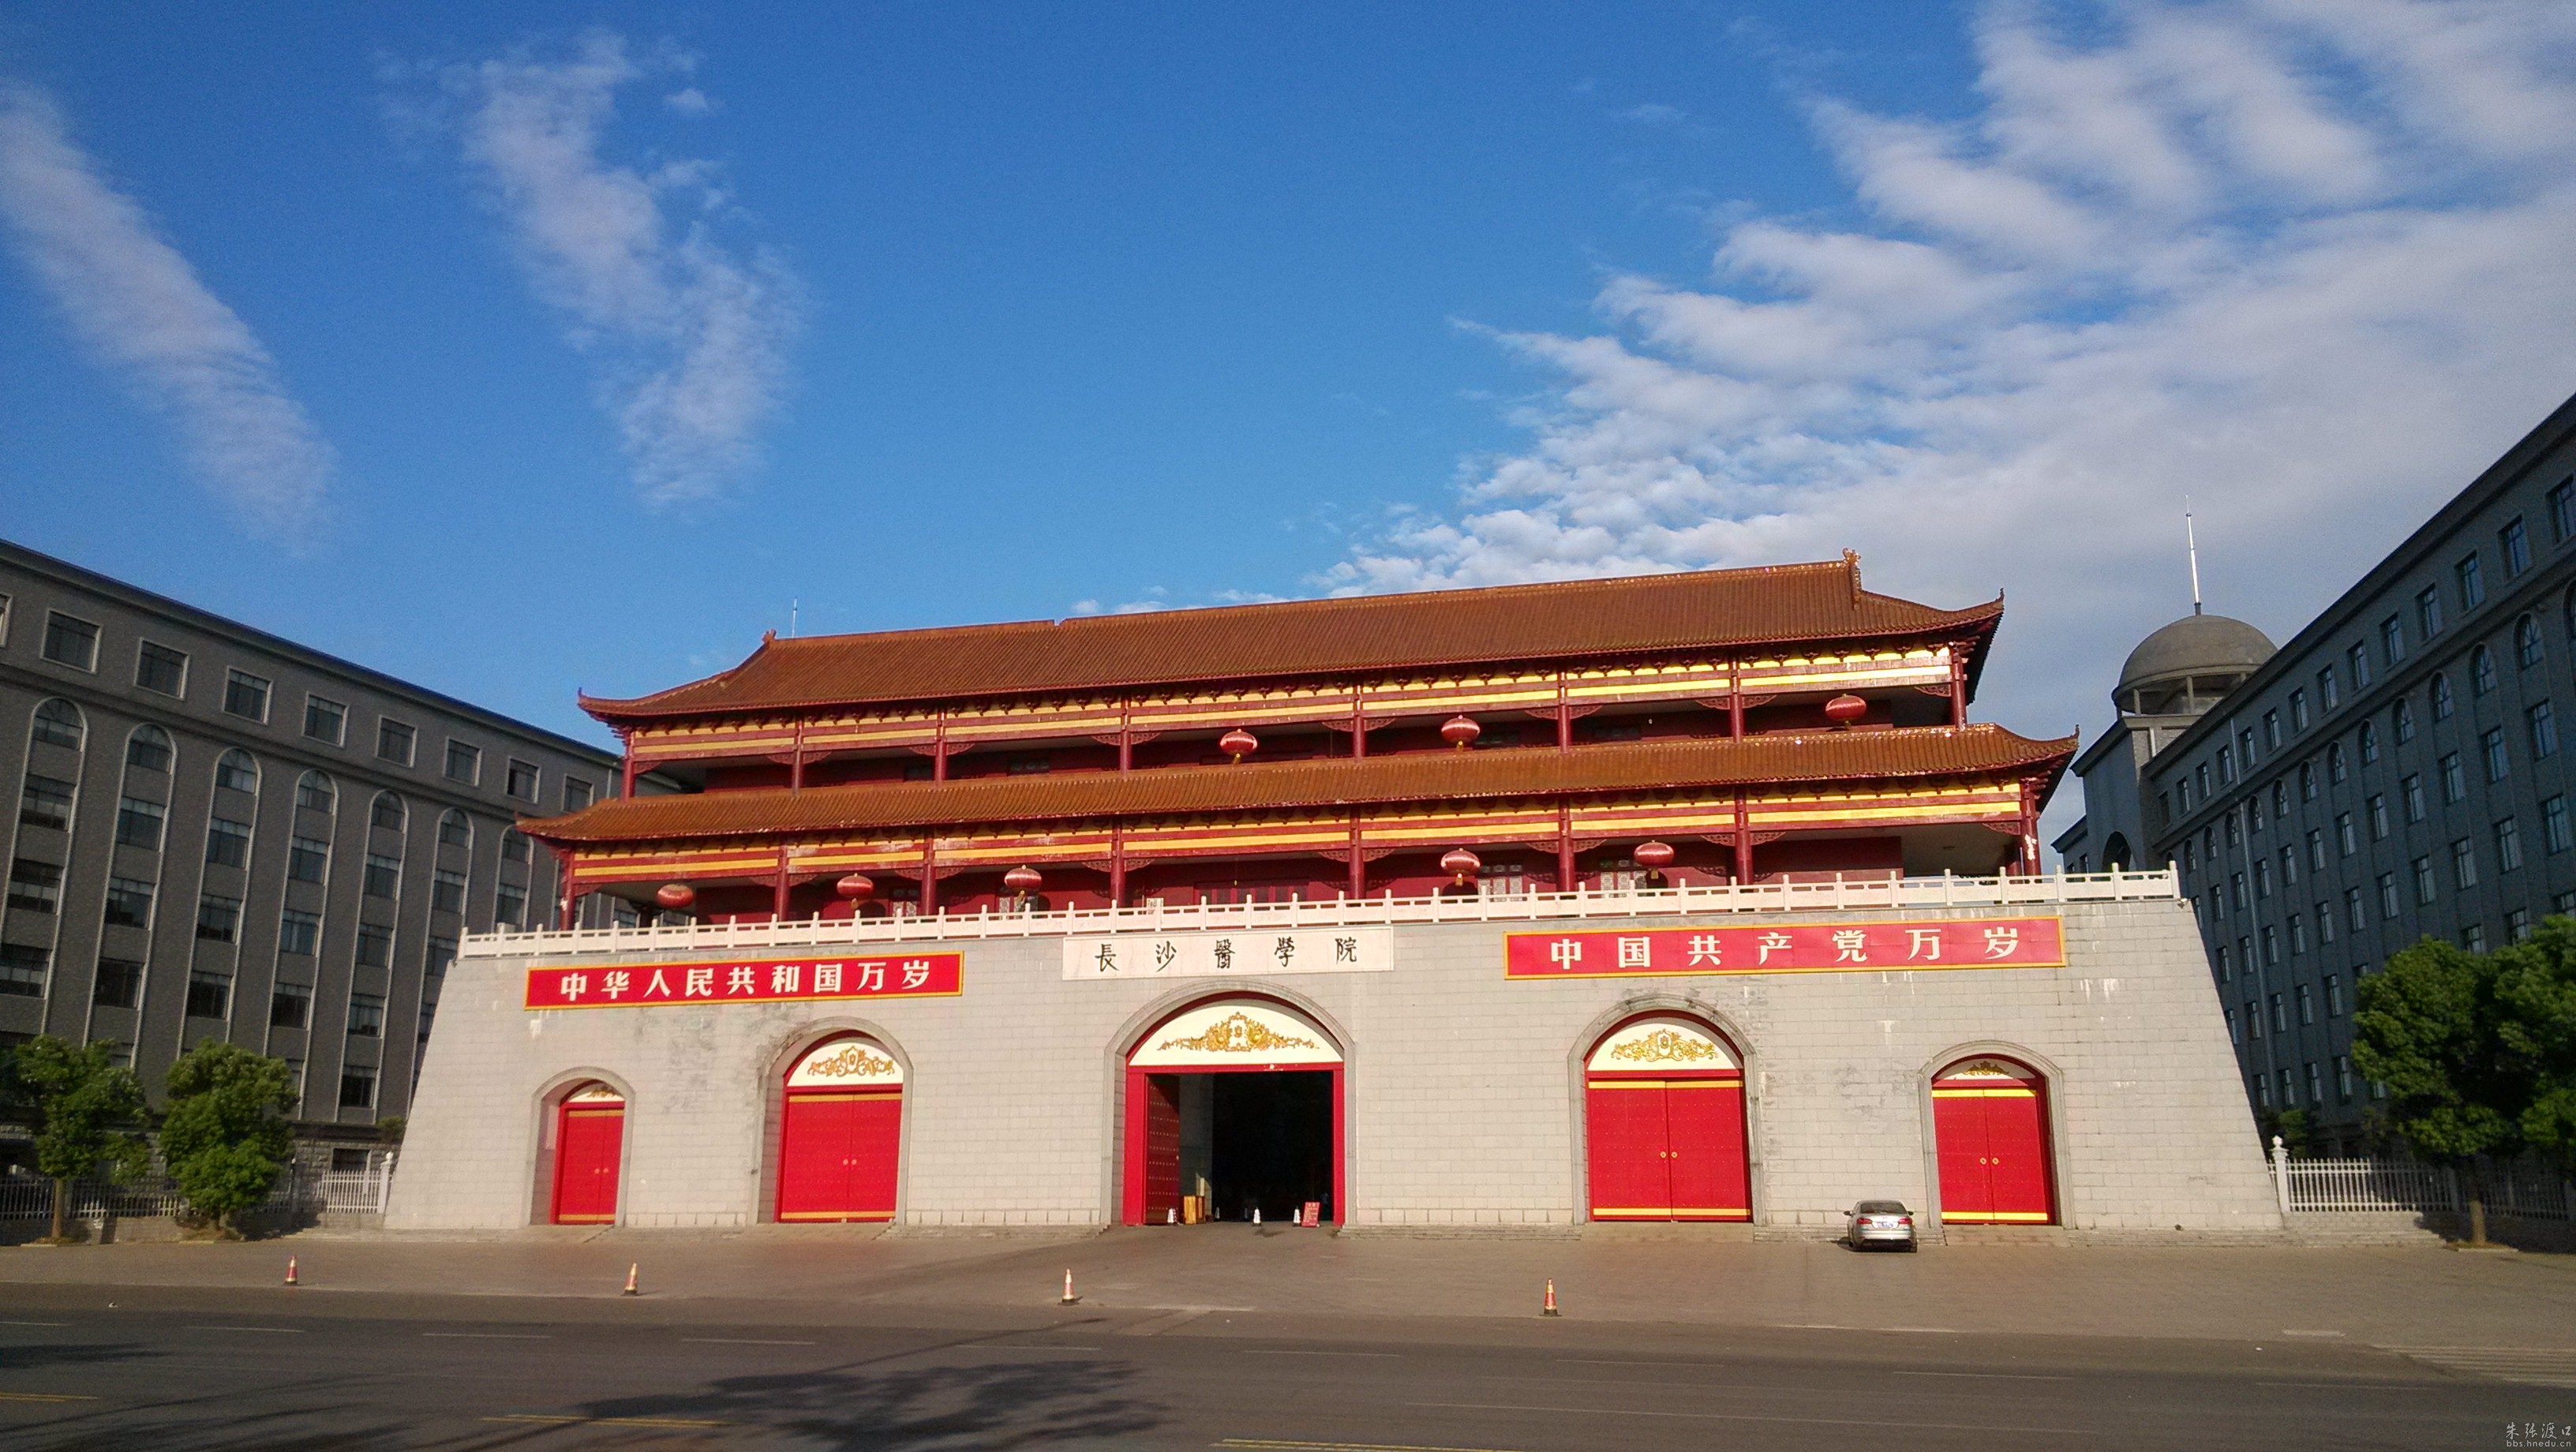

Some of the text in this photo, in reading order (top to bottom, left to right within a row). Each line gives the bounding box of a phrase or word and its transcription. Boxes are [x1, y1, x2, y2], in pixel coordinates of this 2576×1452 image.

[1095, 936, 1357, 972] 長沙醫學院
[1550, 926, 2020, 970] 中国共产党万岁
[560, 959, 930, 1001] 中华人民共和国万岁
